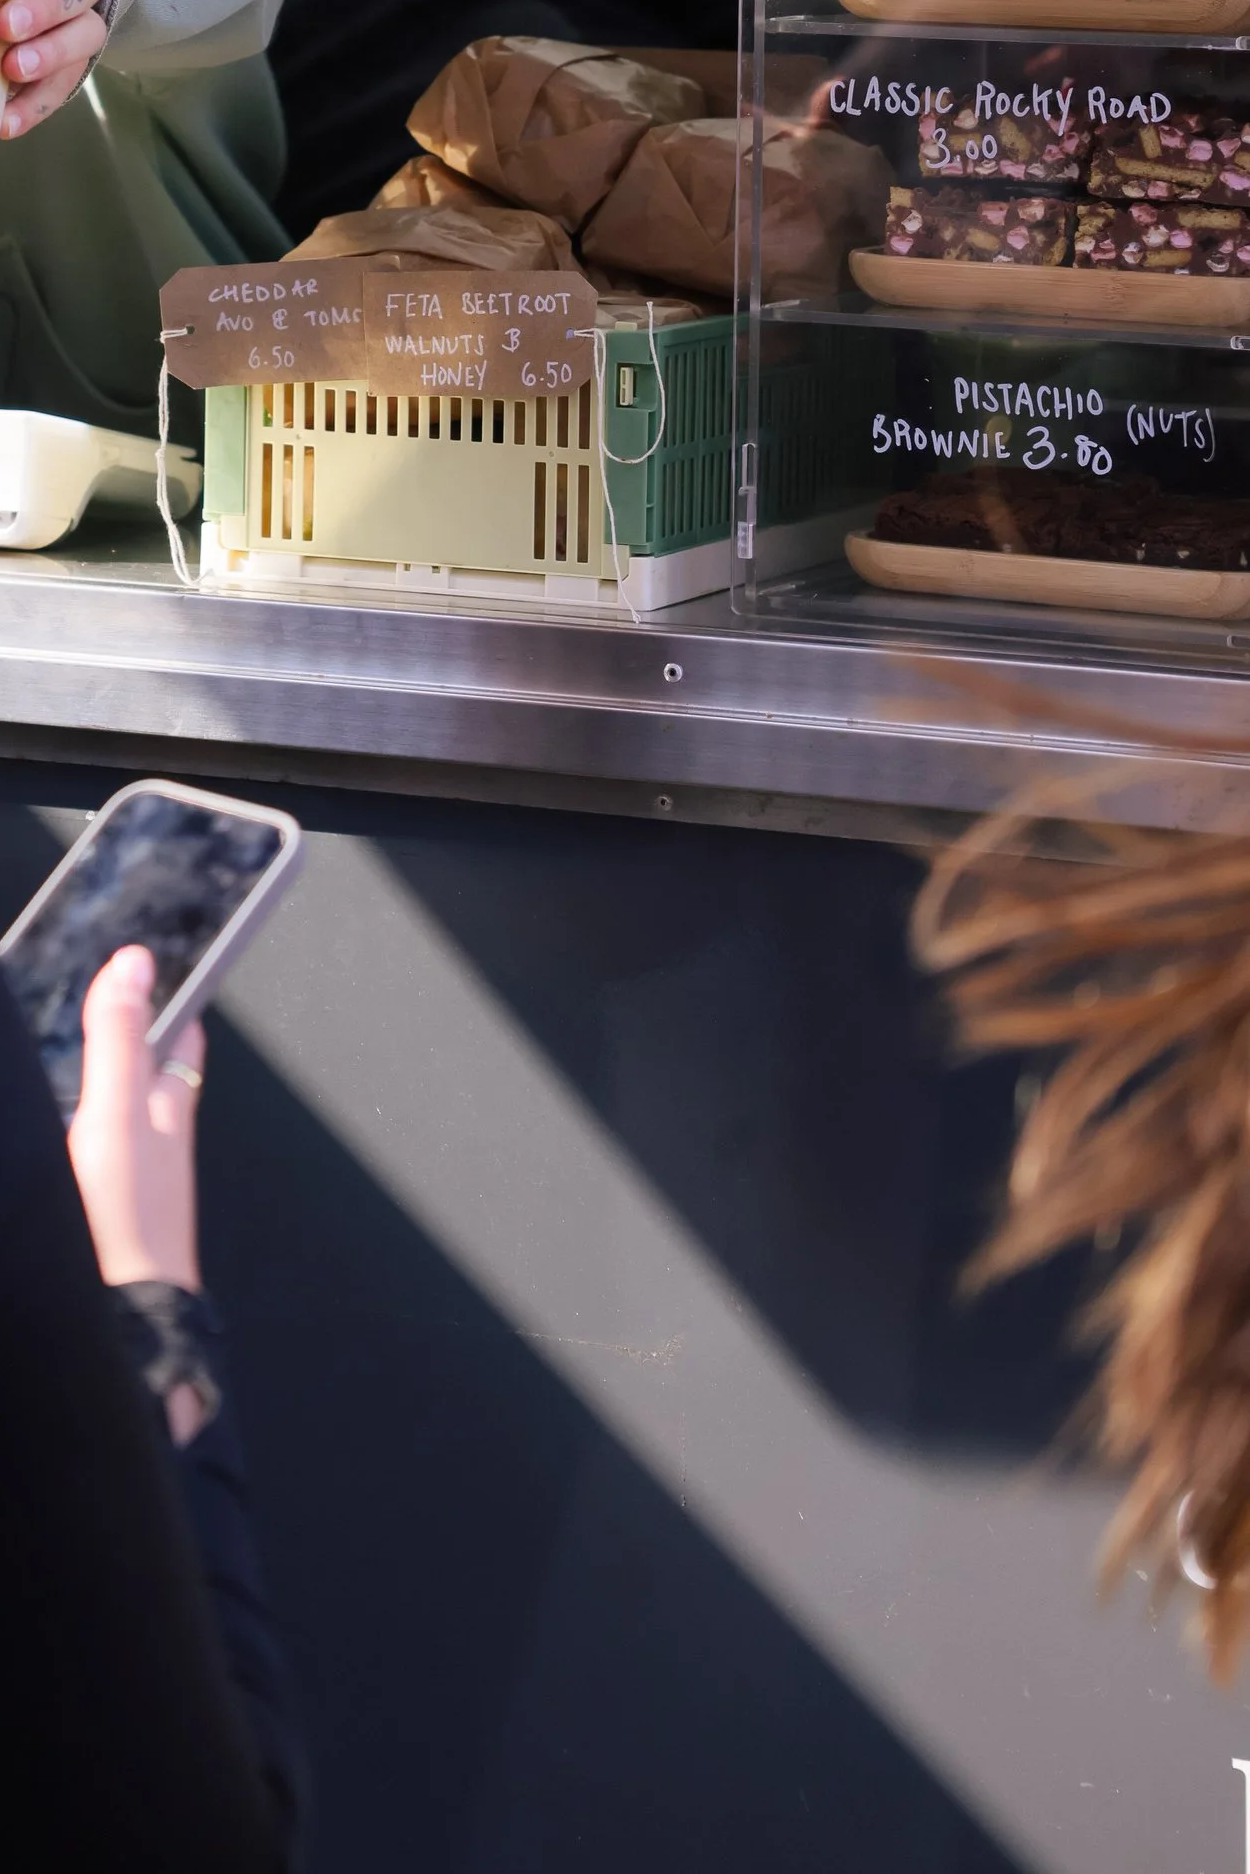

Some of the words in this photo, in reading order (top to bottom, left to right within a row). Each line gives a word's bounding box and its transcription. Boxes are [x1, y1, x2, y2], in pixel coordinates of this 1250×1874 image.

[829, 76, 954, 117] CLASSIC
[974, 80, 1074, 136] ROCKY
[1087, 86, 1172, 124] ROAD
[925, 127, 999, 170] 3.00
[208, 278, 318, 303] CHEDDAR
[385, 293, 443, 319] FETA
[216, 311, 254, 332] AVO
[248, 345, 296, 370] 6.50
[384, 334, 485, 357] WALNUTS
[420, 359, 488, 391] HONEY
[521, 361, 573, 389] 6.50
[953, 376, 1104, 419] PISTACHIO
[1126, 404, 1217, 463] (NUTS)
[871, 413, 1011, 459] BROWNIE
[1022, 425, 1113, 476] 3.80
